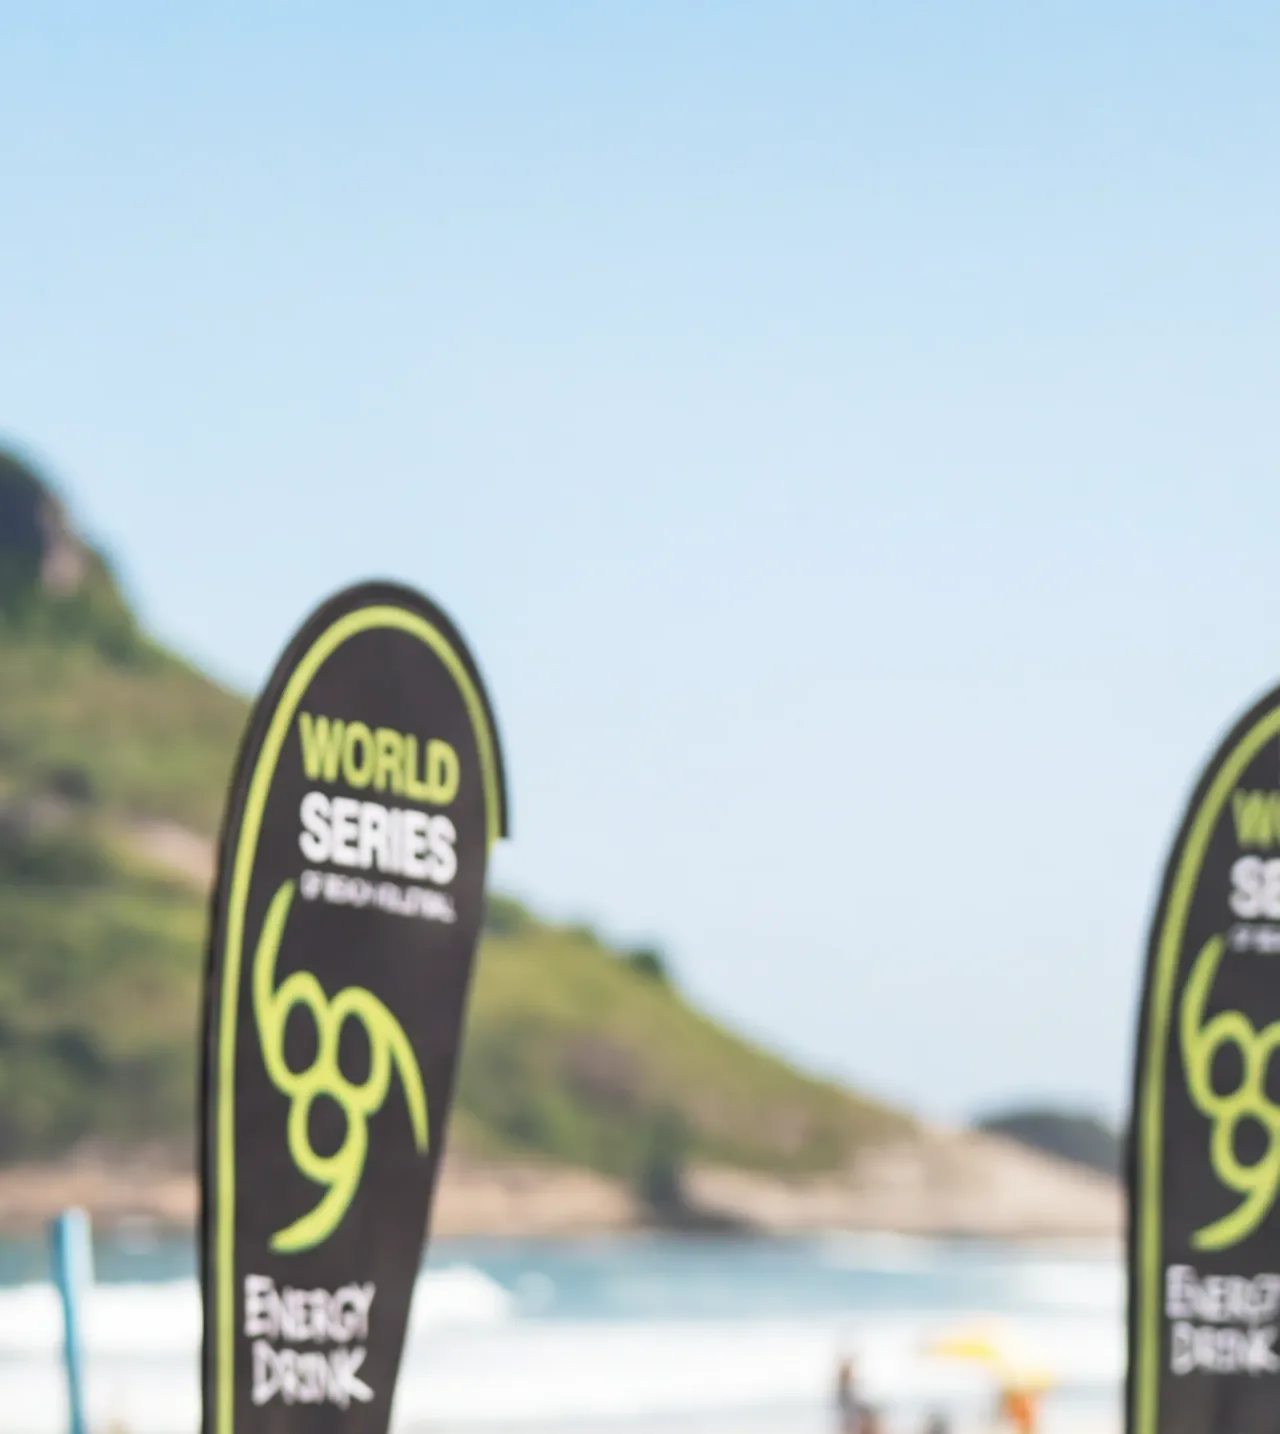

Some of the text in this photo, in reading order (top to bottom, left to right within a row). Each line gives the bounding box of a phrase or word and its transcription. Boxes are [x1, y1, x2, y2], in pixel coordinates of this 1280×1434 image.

[298, 711, 460, 806] WORLD
[299, 791, 458, 886] SERIES
[251, 1339, 376, 1410] DRINK
